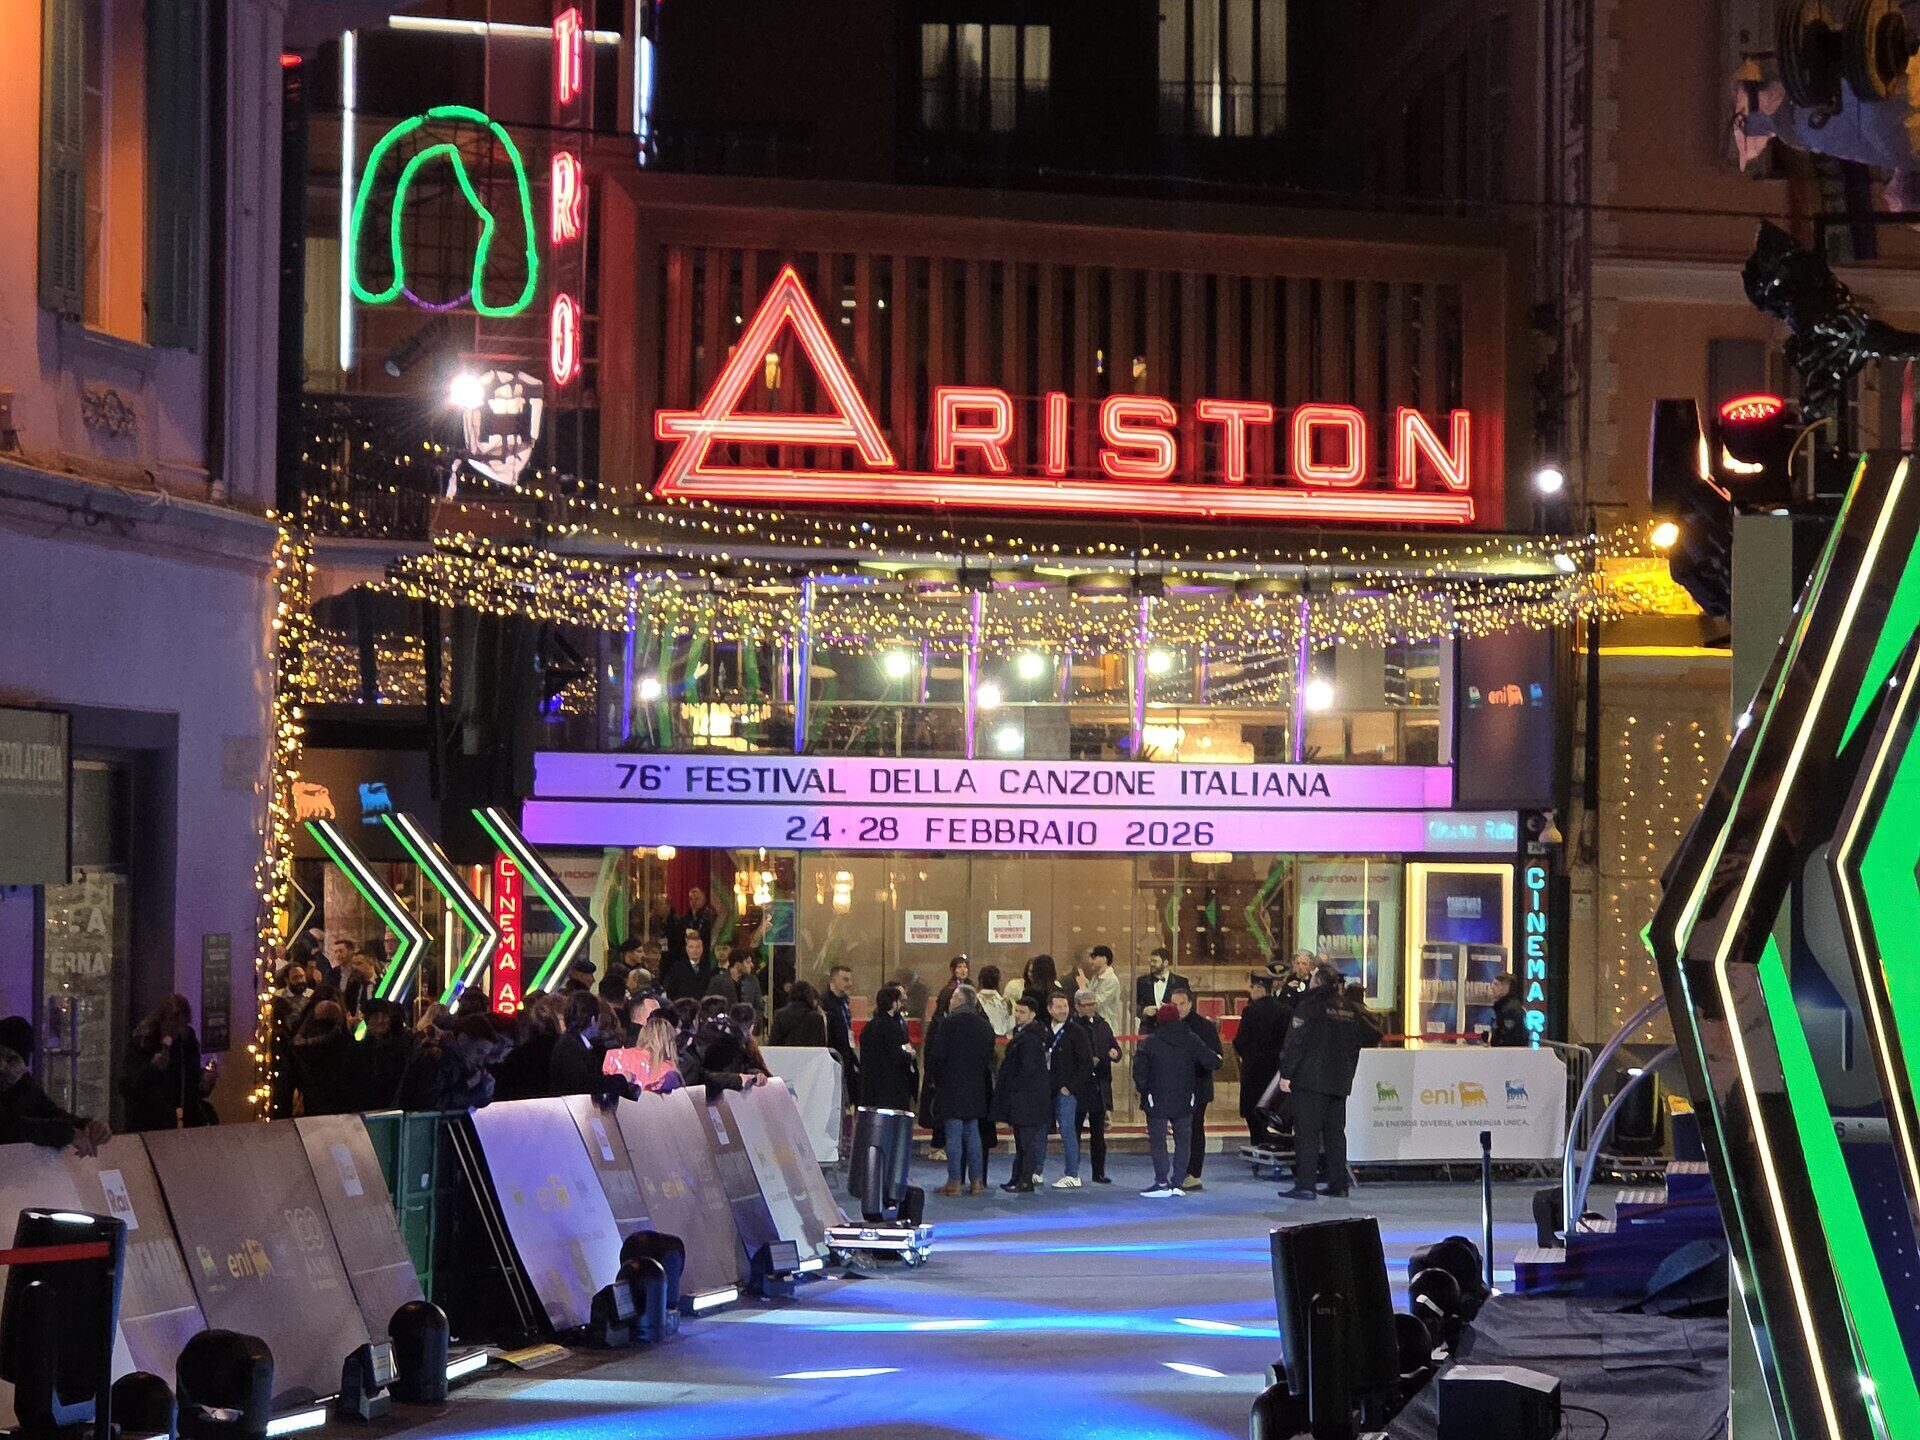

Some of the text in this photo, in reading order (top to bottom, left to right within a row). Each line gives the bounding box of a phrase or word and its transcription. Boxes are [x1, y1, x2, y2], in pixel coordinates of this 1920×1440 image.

[655, 263, 1474, 498] ARISTON
[685, 766, 846, 794] FESTIVAL
[869, 768, 978, 794] DELLA
[999, 769, 1156, 795] CANZONE
[1181, 770, 1332, 797] ITALIANA
[926, 817, 1097, 846] FEBBRAIO
[1125, 821, 1215, 846] 2026
[499, 858, 516, 970] CINEMA
[1527, 867, 1546, 1003] CINEMA
[1420, 1083, 1455, 1105] eni
[106, 1186, 131, 1213] Rai
[227, 1243, 255, 1278] eni
